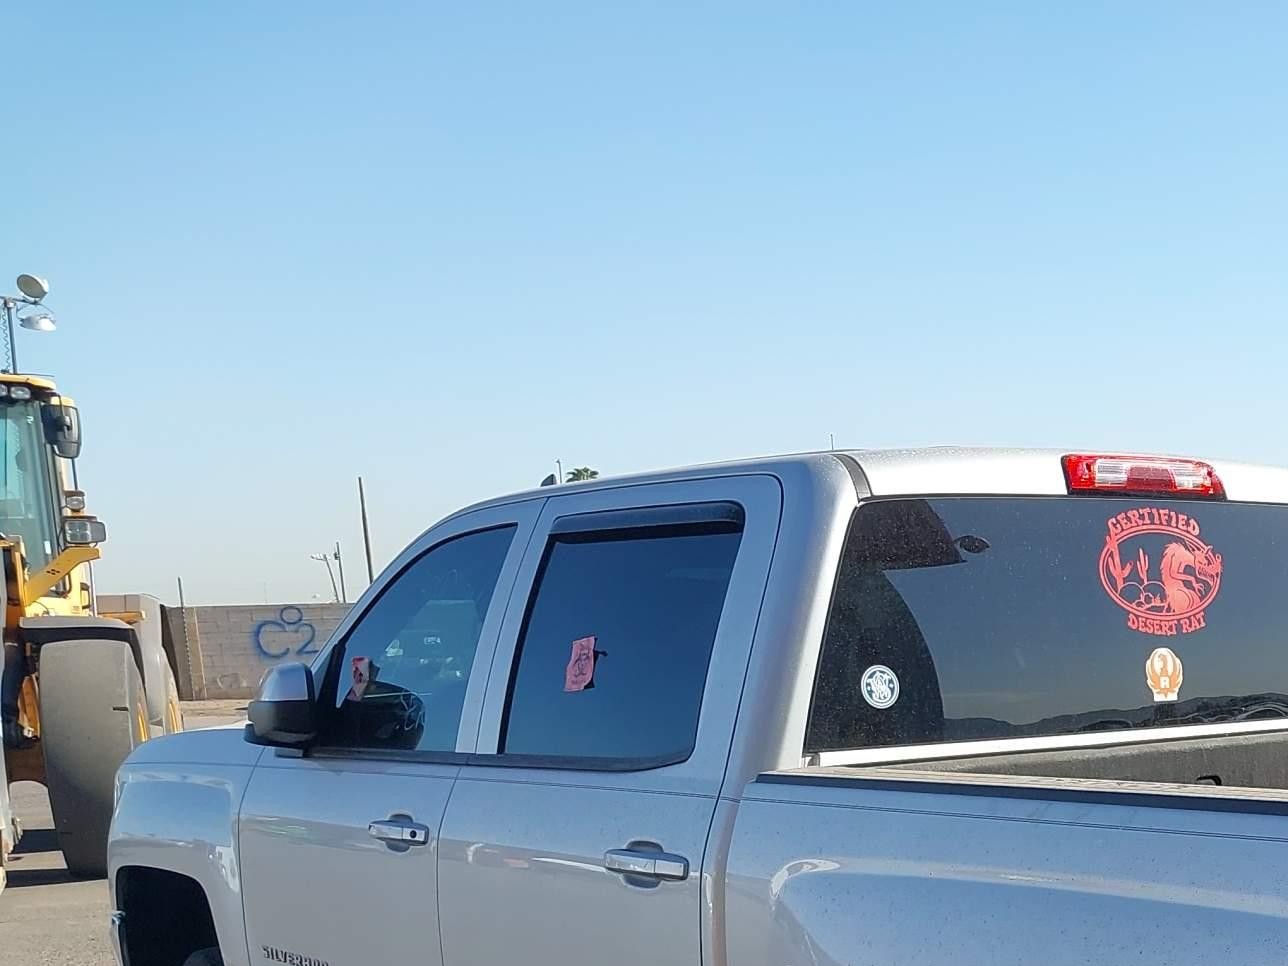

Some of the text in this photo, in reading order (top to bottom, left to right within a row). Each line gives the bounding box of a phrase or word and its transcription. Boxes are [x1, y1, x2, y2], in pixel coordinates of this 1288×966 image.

[1108, 507, 1200, 535] CERTIFIED
[1127, 612, 1206, 636] DESERT RAT
